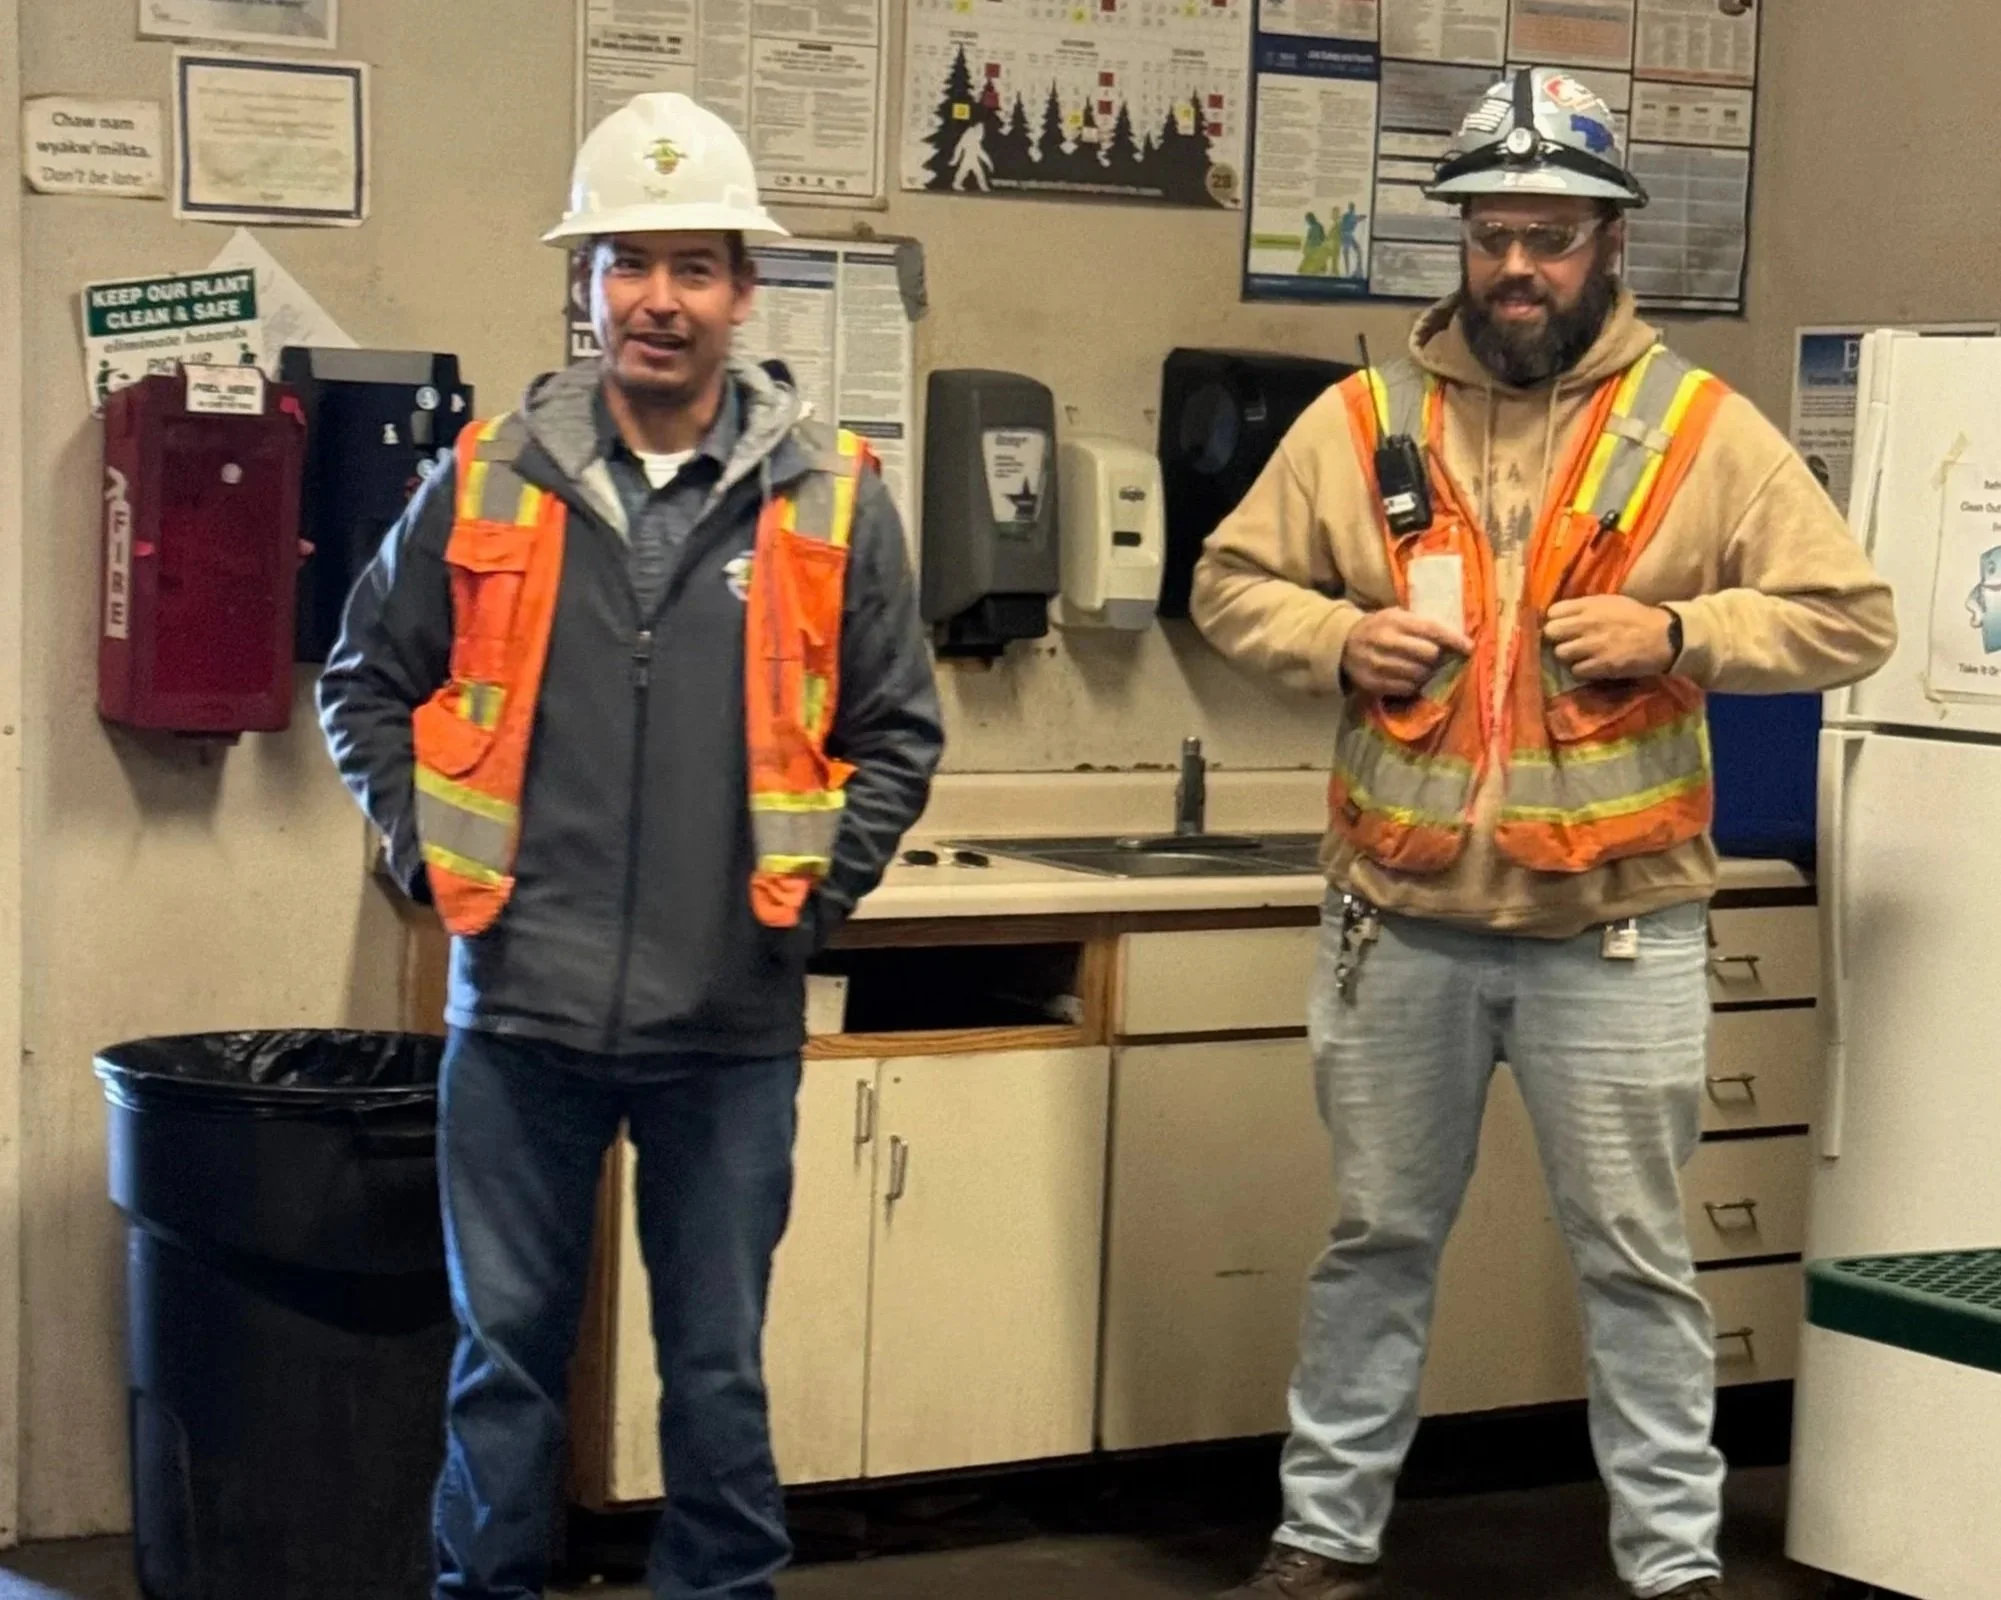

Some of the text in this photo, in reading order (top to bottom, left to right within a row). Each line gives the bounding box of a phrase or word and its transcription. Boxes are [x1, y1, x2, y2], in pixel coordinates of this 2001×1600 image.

[88, 168, 108, 184] be
[91, 275, 250, 308] KEEP OUR PLANT
[105, 299, 241, 330] CLEAN & SAFE
[104, 325, 249, 353] eliminate hazards
